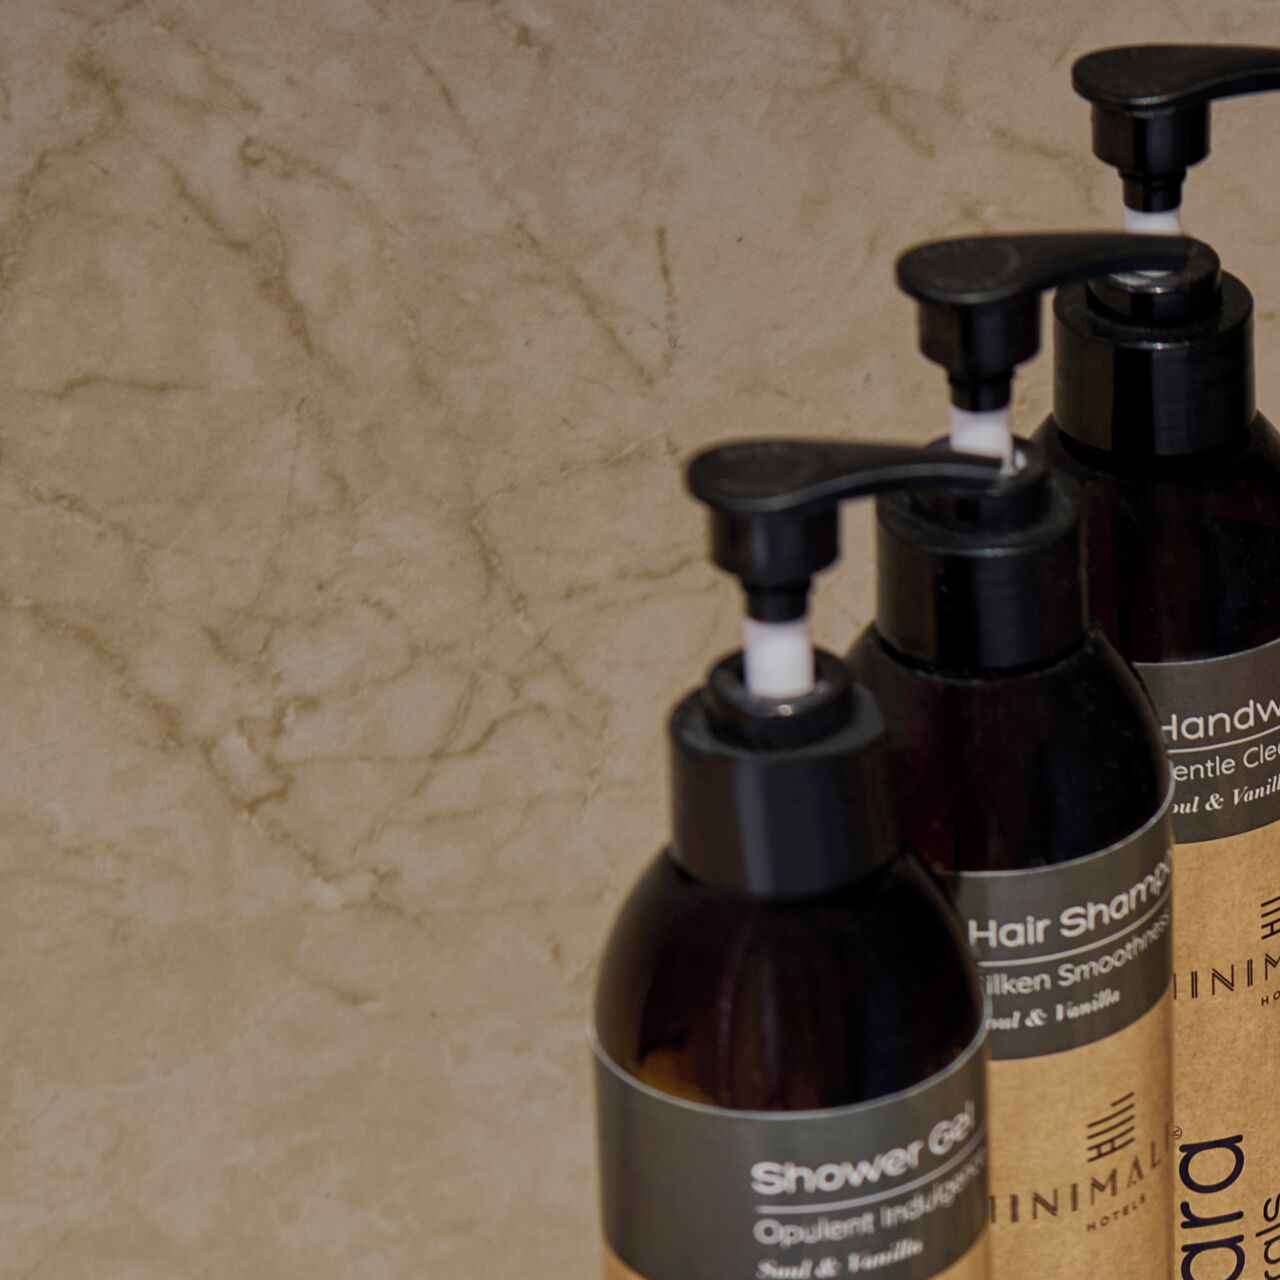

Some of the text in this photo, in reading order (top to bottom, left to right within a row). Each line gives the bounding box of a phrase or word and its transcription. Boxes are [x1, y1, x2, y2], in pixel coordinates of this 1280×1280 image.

[1172, 756, 1236, 781] entle
[1205, 793, 1224, 811] &
[969, 916, 1051, 948] Hair
[980, 972, 1051, 997] ilken
[984, 988, 1121, 1030] oul & Vanilla
[751, 1099, 976, 1196] Shower Gel
[753, 1211, 875, 1249] Opulent
[1086, 1193, 1148, 1233] HOTELS
